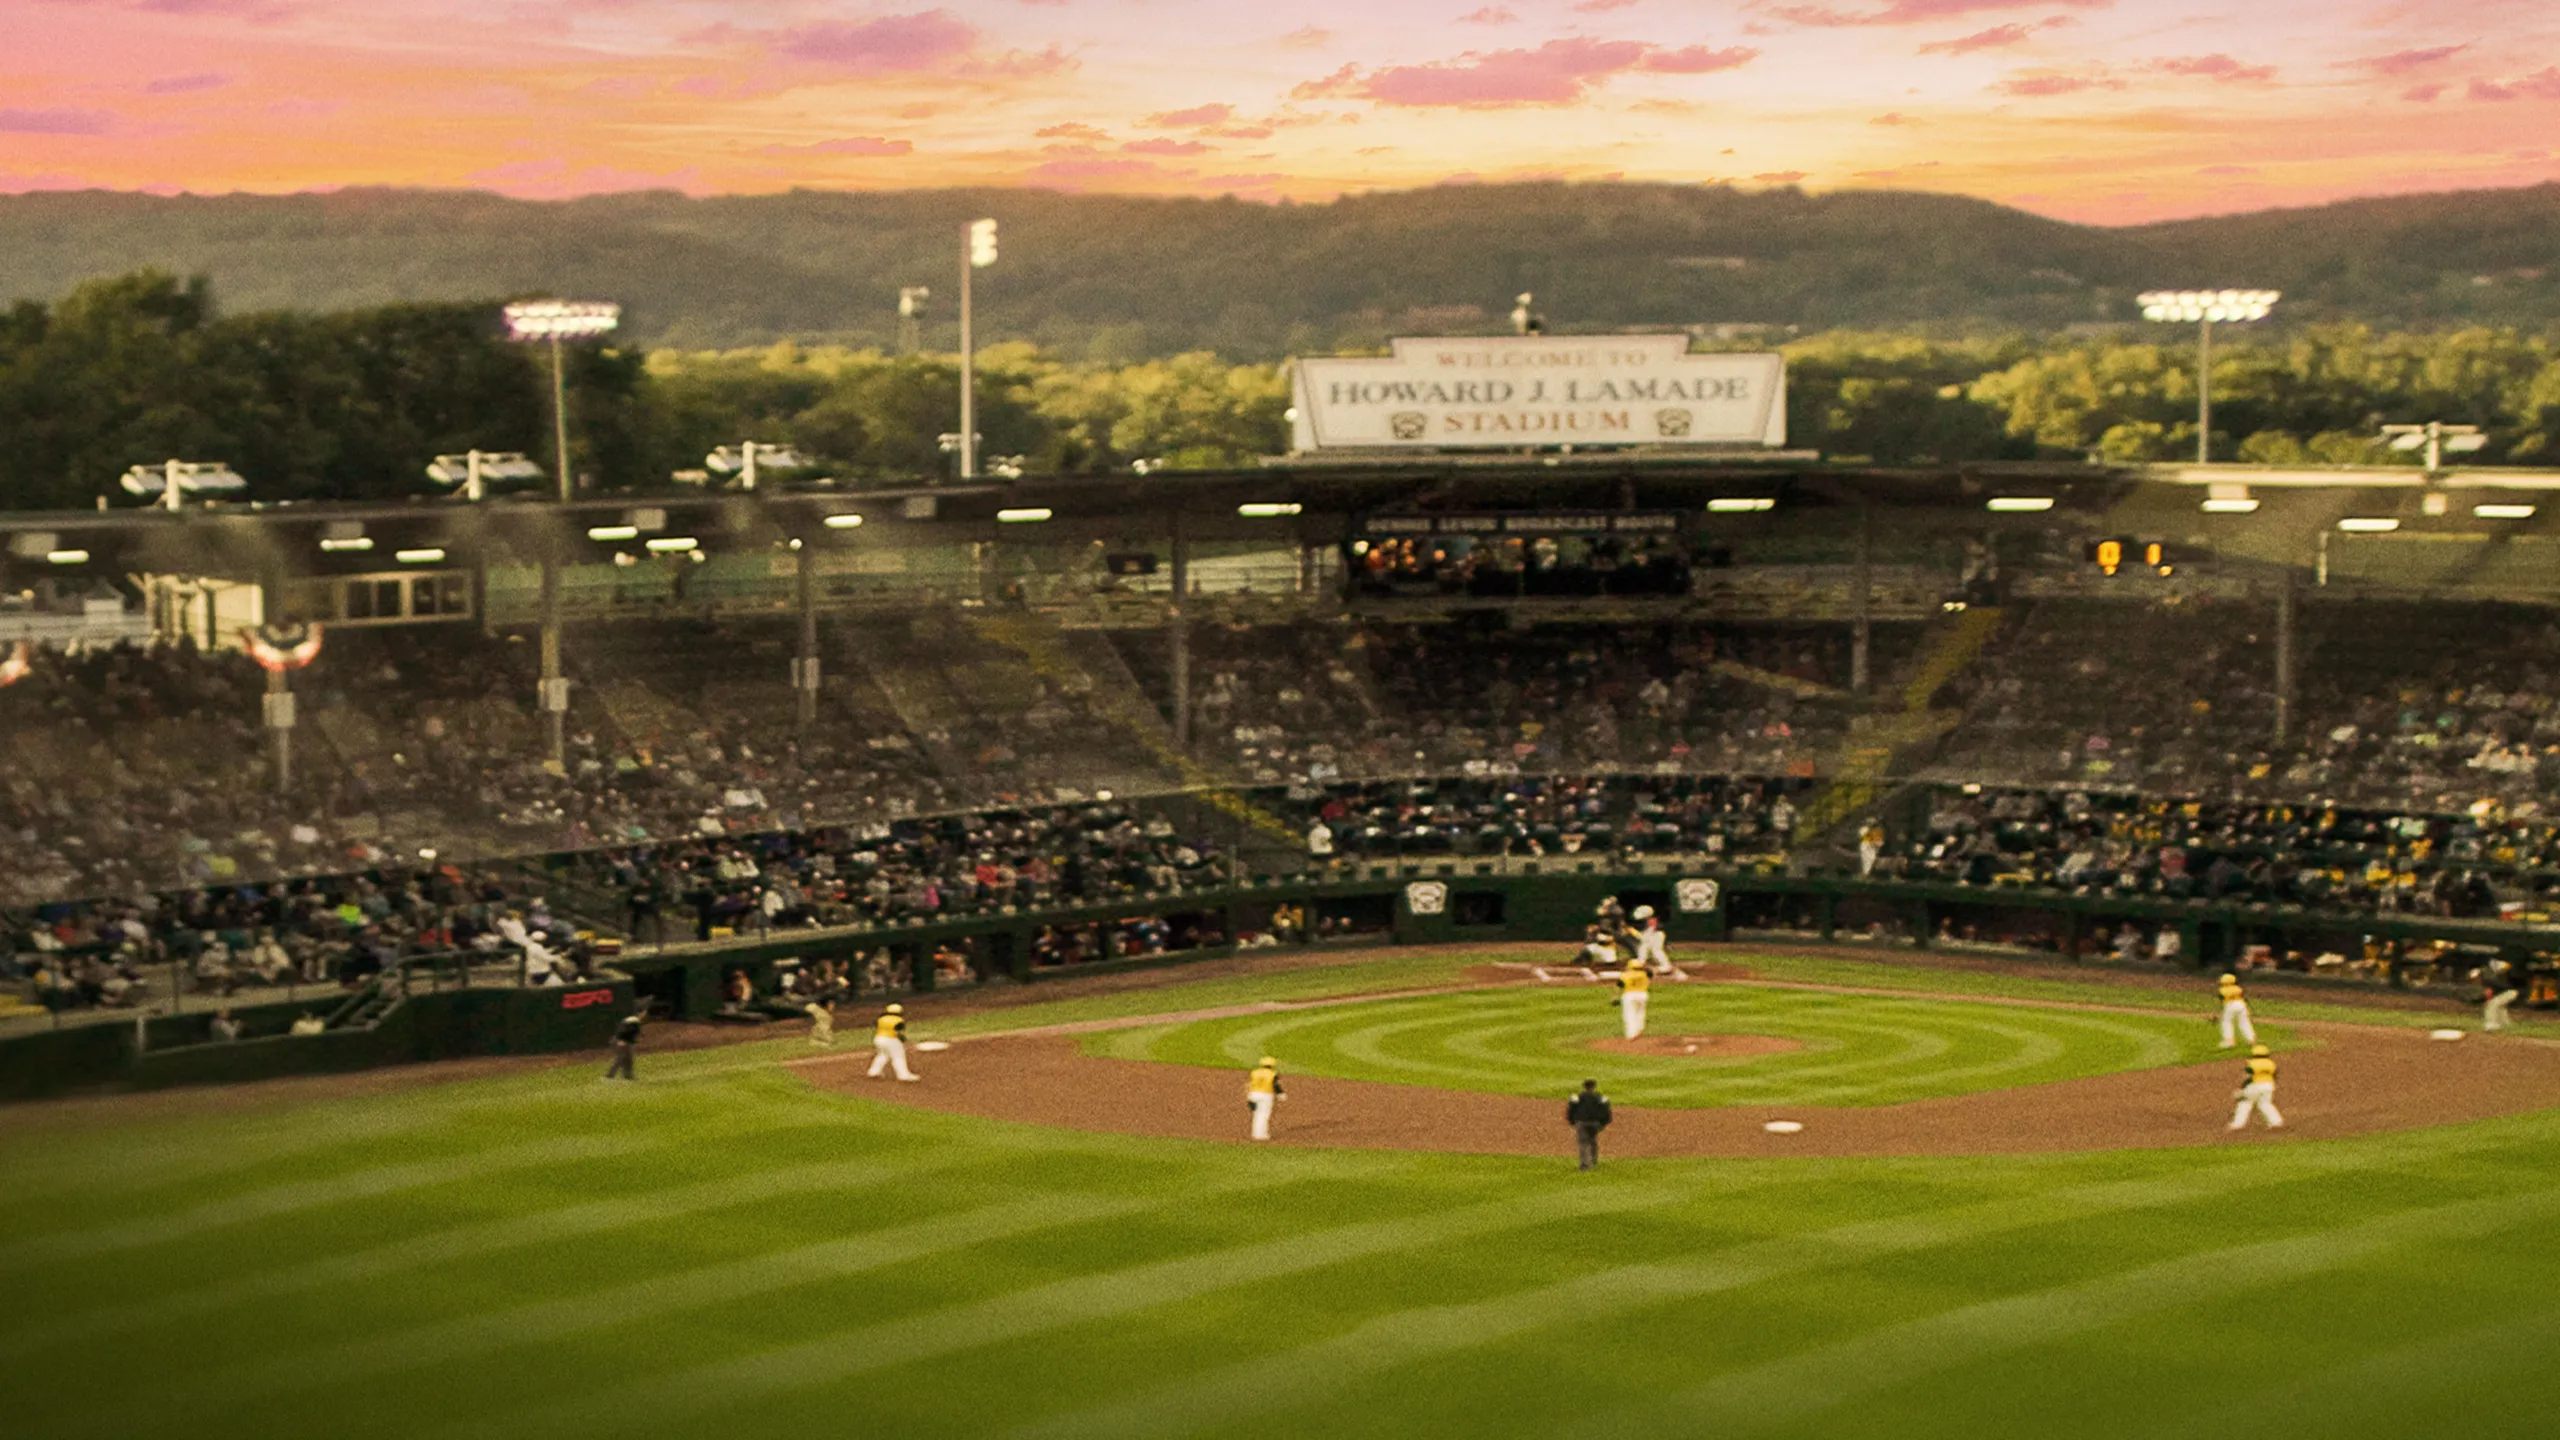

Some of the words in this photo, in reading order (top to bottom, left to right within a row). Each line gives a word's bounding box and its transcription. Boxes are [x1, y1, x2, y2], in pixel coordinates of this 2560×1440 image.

[1436, 351, 1592, 367] WELCOME
[1608, 350, 1647, 366] TO
[1329, 380, 1514, 405] HOWARD
[1566, 377, 1750, 402] LAMADE
[1443, 410, 1630, 432] STADIUM
